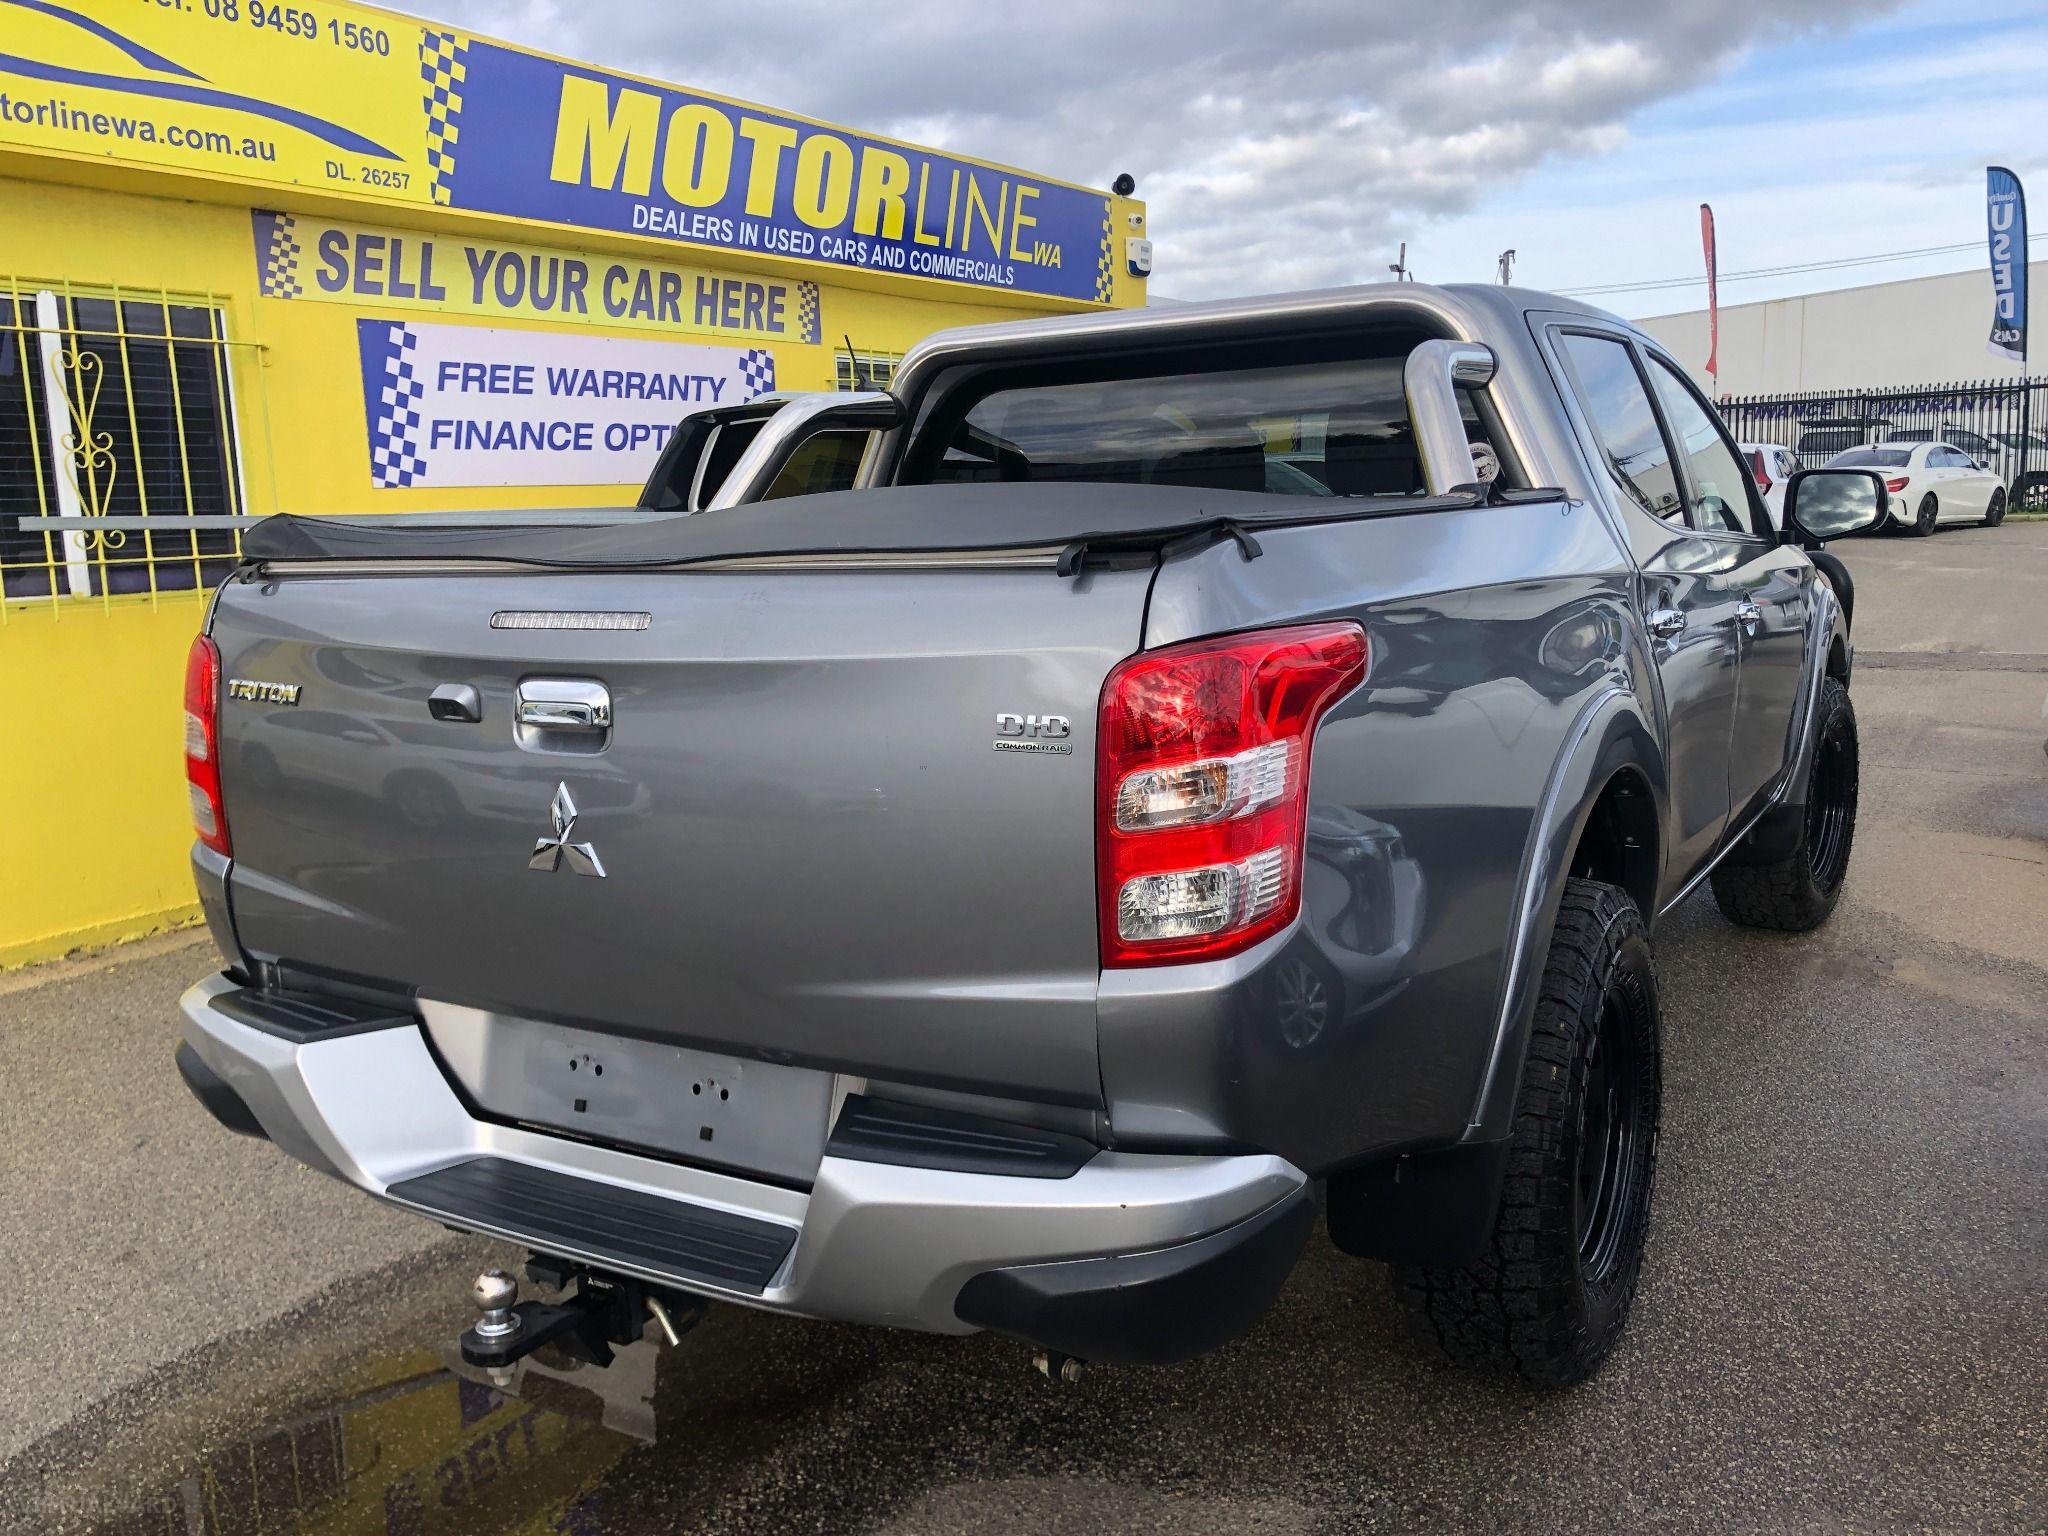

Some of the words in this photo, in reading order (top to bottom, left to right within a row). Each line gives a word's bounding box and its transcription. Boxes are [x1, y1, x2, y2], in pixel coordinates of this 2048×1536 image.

[205, 0, 239, 22] 08
[249, 2, 317, 39] 9459
[328, 18, 390, 56] 1560
[0, 92, 276, 162] torlinewa.com.au
[325, 160, 355, 182] DL.
[361, 166, 411, 190] 26257
[632, 203, 733, 243] DEALERS
[738, 224, 758, 248] IN
[763, 226, 815, 255] USED
[819, 236, 867, 264] CARS
[870, 245, 905, 269] AND
[909, 250, 1014, 286] COMMERCIALS
[1032, 241, 1062, 269] WA
[315, 229, 445, 301] SELL
[464, 246, 589, 315] YOUR
[602, 264, 682, 324] CAR
[694, 275, 787, 333] HERE
[437, 361, 535, 395] FREE
[546, 366, 727, 403] WARRANTY
[430, 419, 594, 451] FINANCE
[228, 679, 302, 707] TRITON
[995, 741, 1040, 752] COMMON
